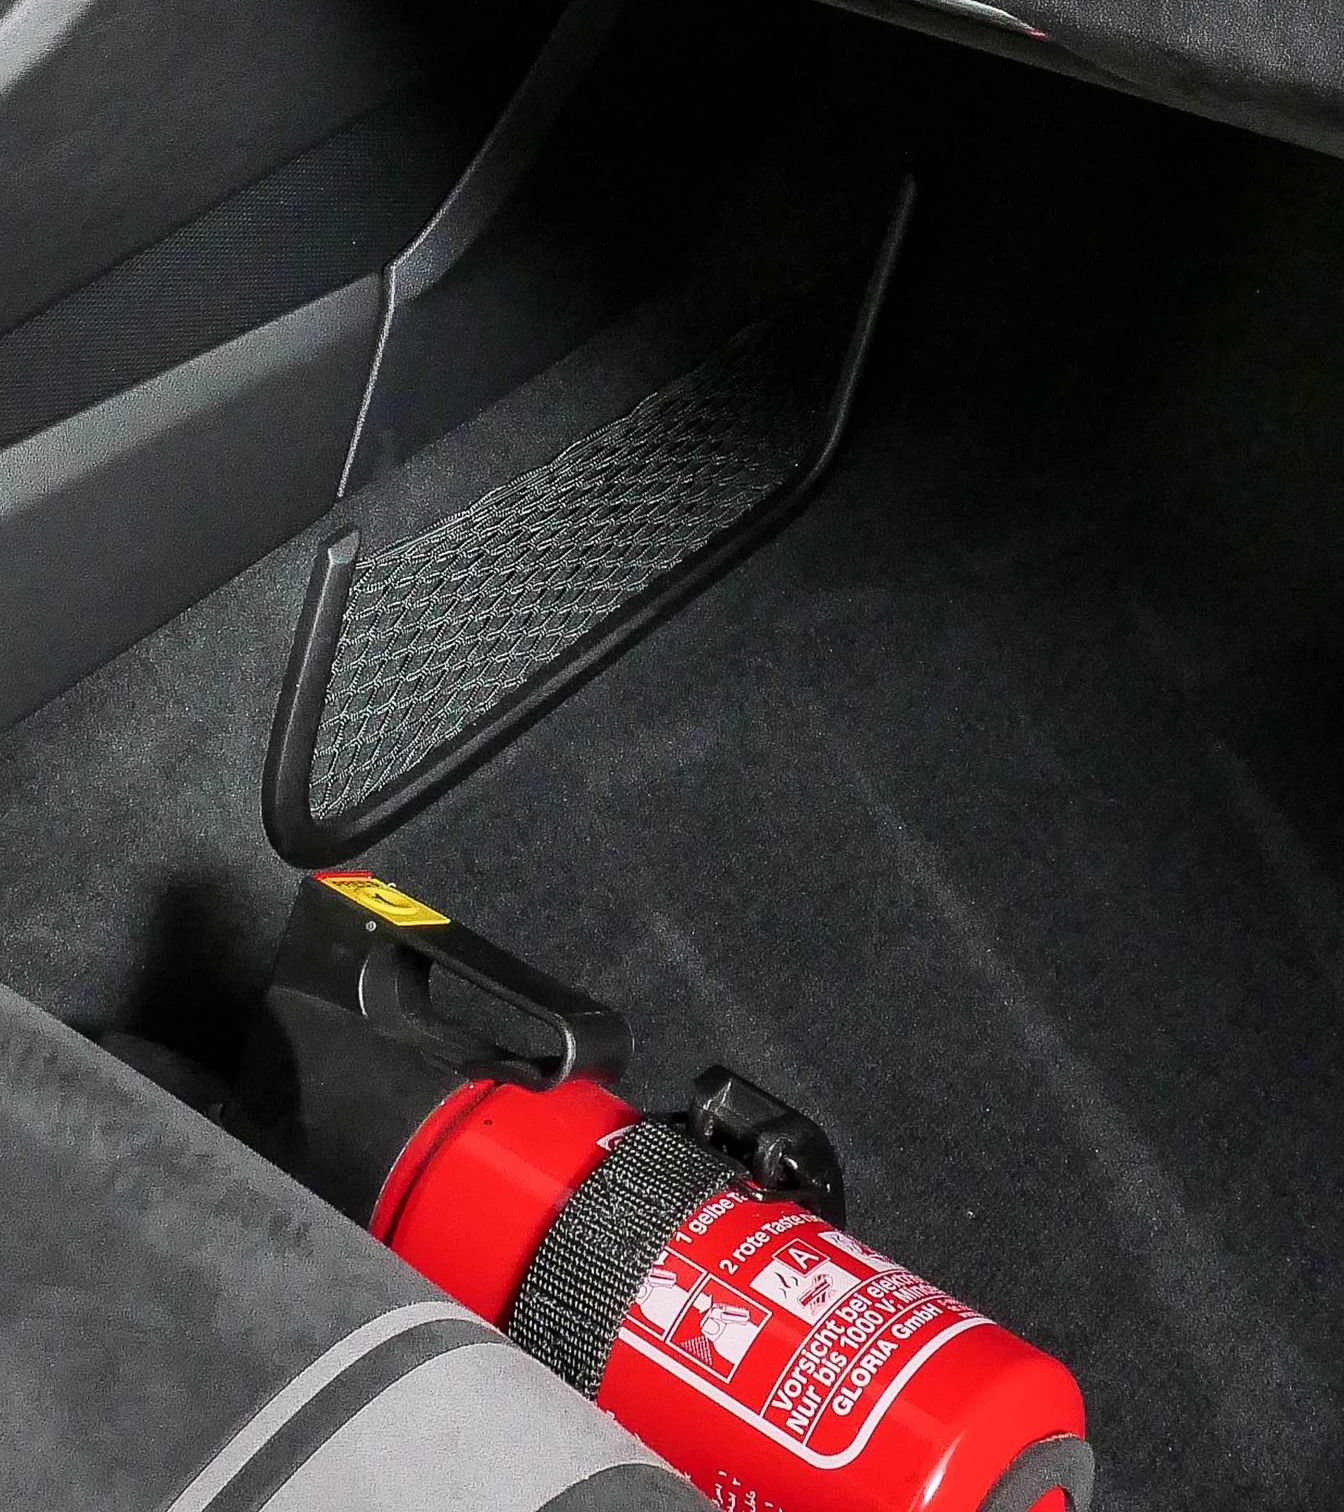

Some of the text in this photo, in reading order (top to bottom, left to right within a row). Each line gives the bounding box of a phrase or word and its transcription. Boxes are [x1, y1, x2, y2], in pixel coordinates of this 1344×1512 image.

[675, 1231, 692, 1244] 1
[688, 1194, 735, 1234] gelbe
[719, 1259, 739, 1275] 2
[735, 1228, 770, 1263] rote
[765, 1213, 805, 1235] Taste
[787, 1246, 819, 1270] A
[770, 1320, 846, 1414] Vorsicht
[836, 1292, 873, 1322] bei
[785, 1386, 823, 1435] Nur
[813, 1350, 849, 1387] bis
[839, 1311, 885, 1350] 1000
[831, 1302, 944, 1417] GLORIA GmbH
